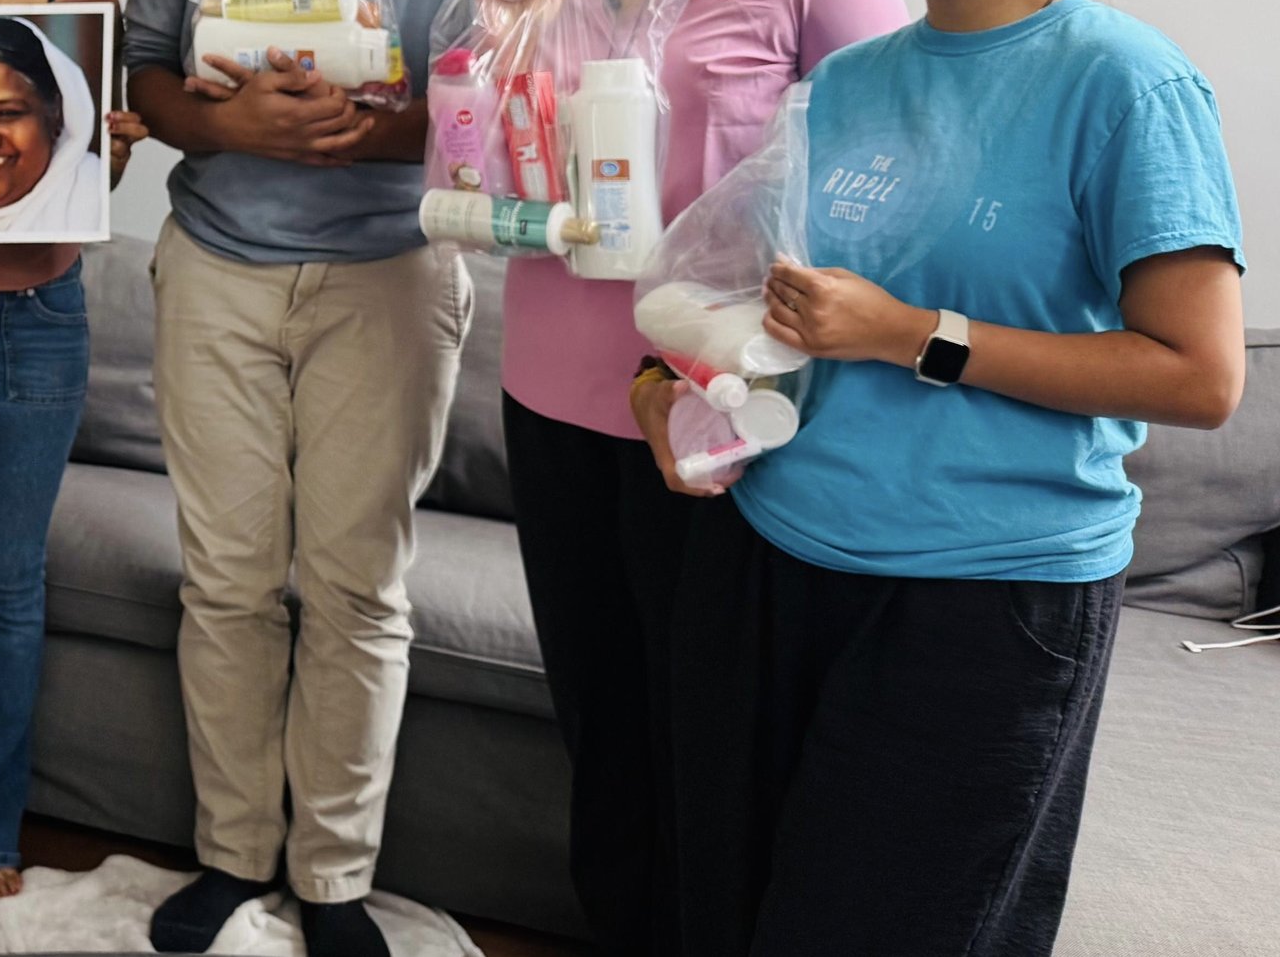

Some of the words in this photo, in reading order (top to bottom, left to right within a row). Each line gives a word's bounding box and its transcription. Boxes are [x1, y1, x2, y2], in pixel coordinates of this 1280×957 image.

[870, 154, 896, 172] THE
[823, 167, 901, 202] RIPPLE
[829, 200, 869, 223] EFFECT
